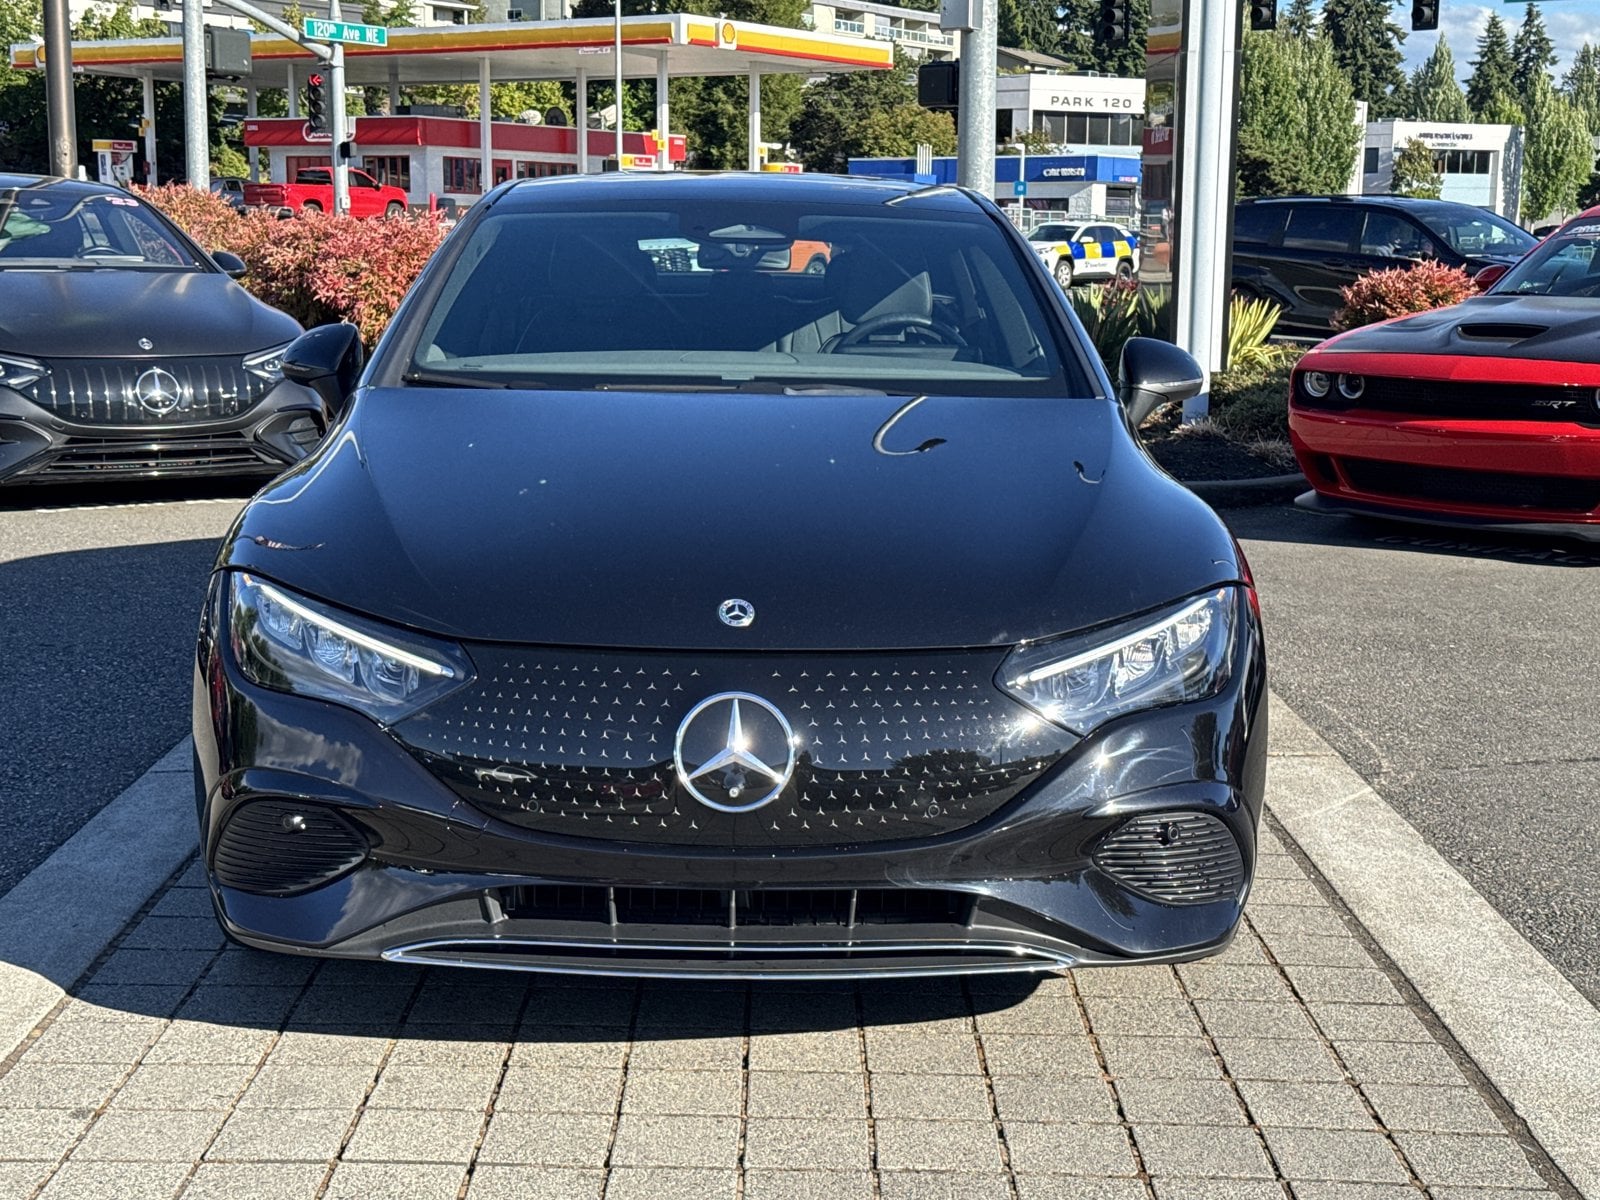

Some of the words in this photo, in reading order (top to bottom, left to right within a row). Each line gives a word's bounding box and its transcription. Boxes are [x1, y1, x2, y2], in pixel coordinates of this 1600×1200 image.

[313, 21, 337, 37] 120th
[342, 25, 360, 41] Ave
[365, 27, 379, 43] NE
[1051, 96, 1094, 107] PARK
[1103, 98, 1132, 108] 120
